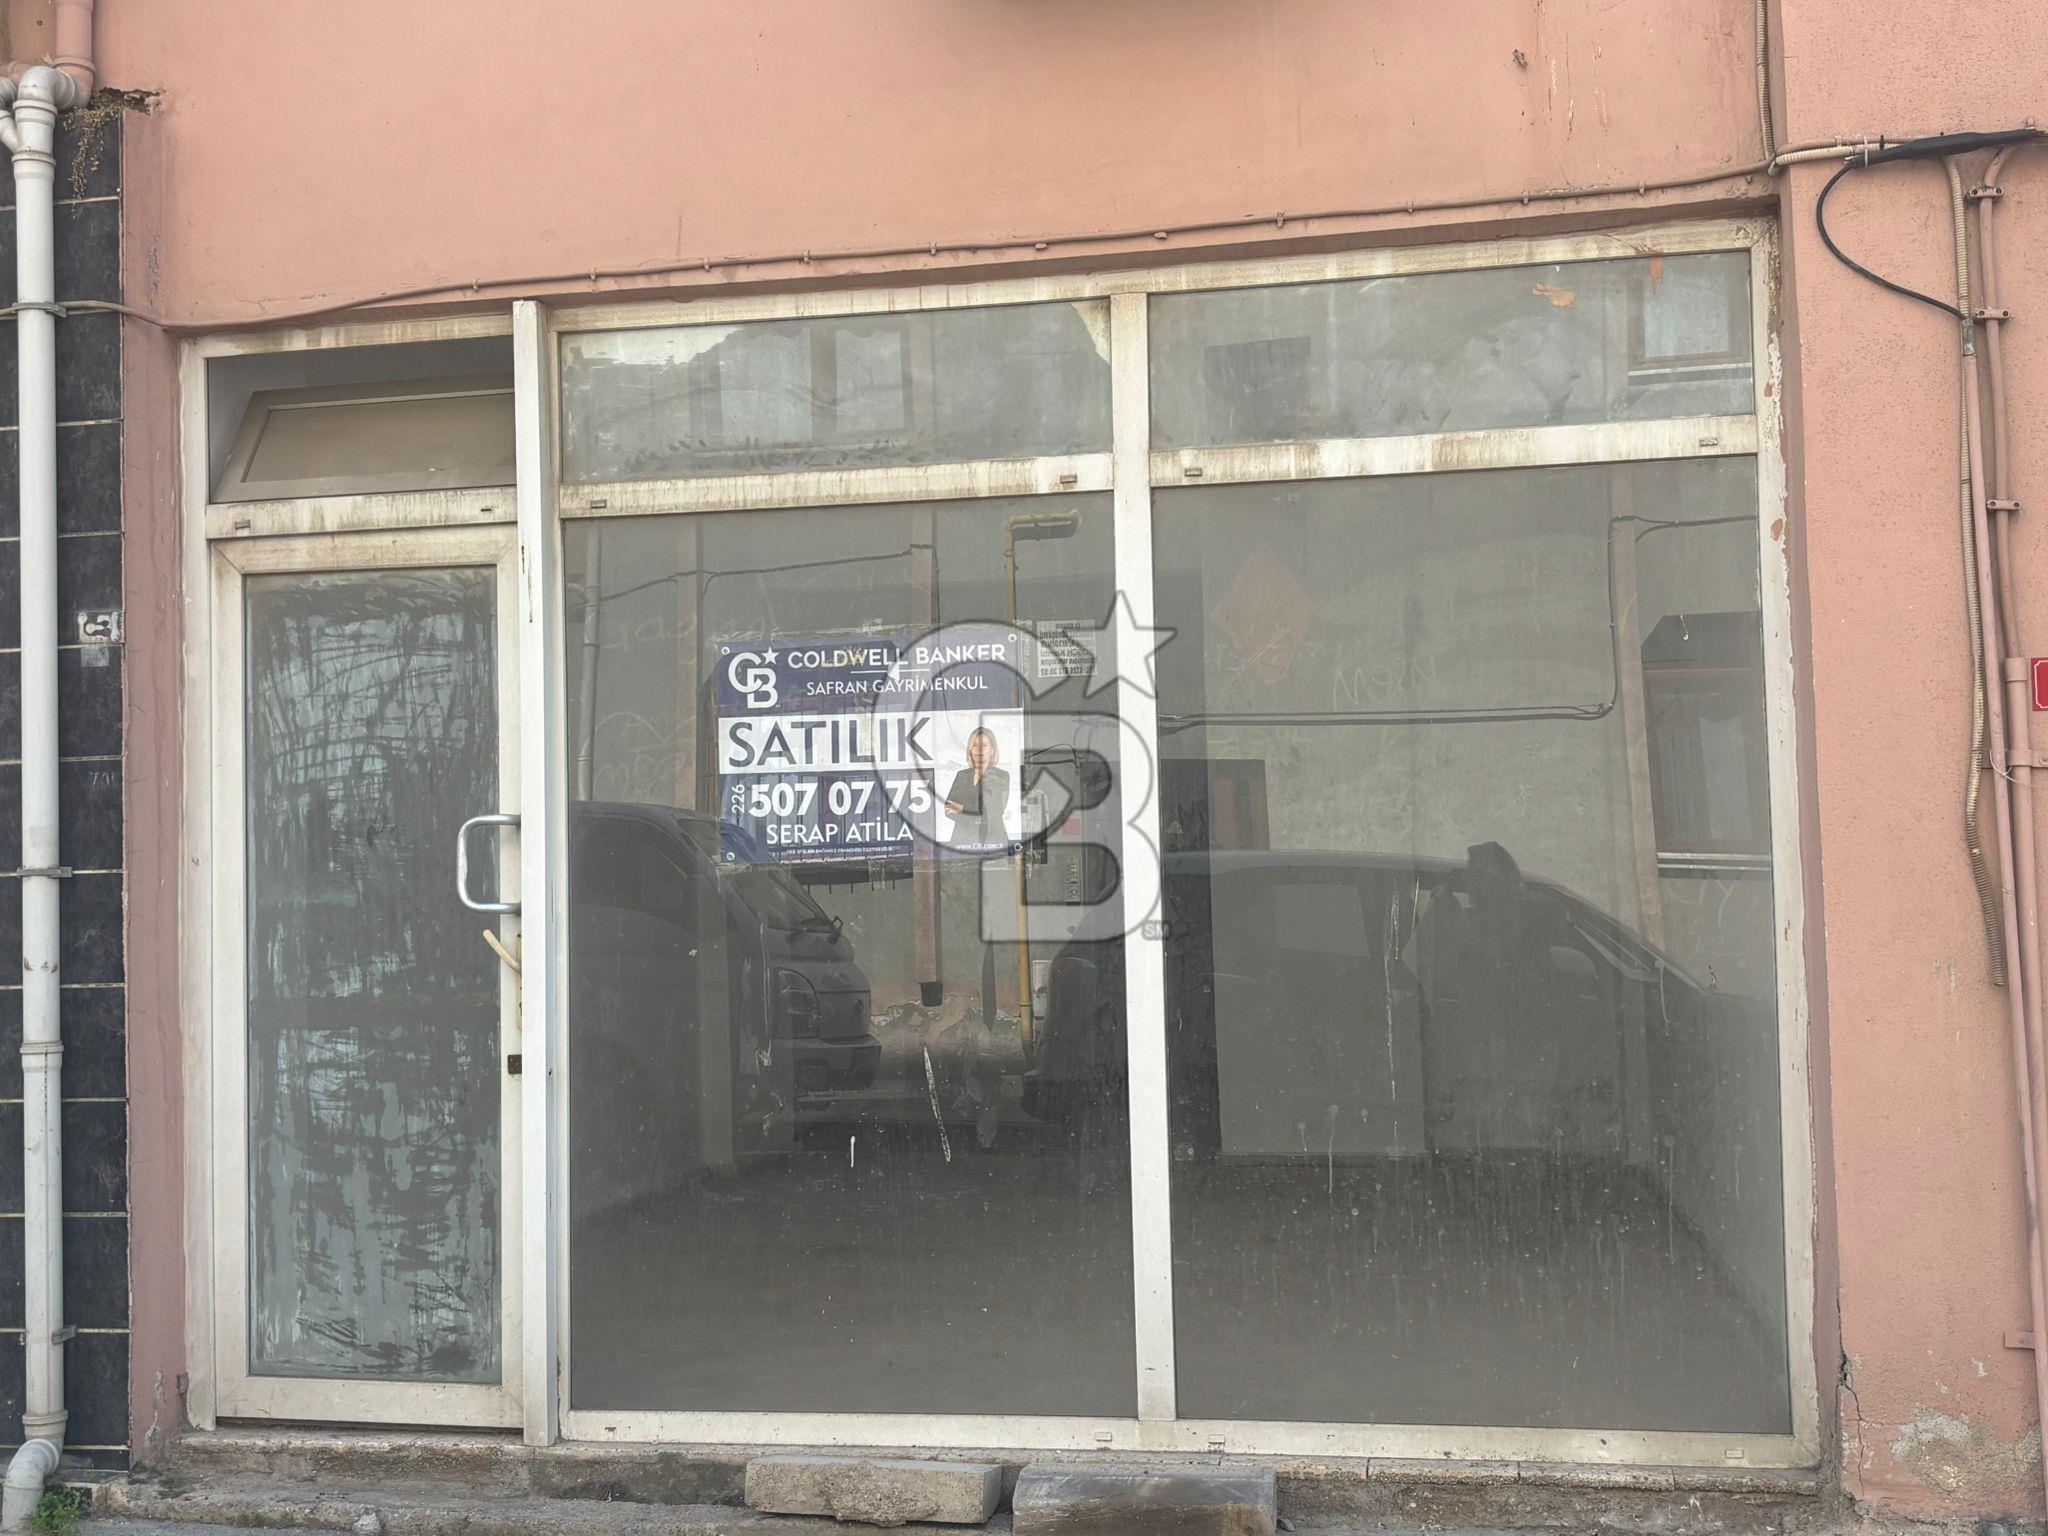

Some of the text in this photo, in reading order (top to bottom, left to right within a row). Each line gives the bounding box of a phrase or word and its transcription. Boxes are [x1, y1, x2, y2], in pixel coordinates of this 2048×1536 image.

[787, 644, 1006, 669] COLDWELL BANKER
[806, 675, 988, 696] SAFRAN GAYRİMENKUL
[728, 717, 933, 768] SATILIK
[731, 779, 932, 818] 226 507 07 75
[766, 816, 914, 845] SERAP ATİLA
